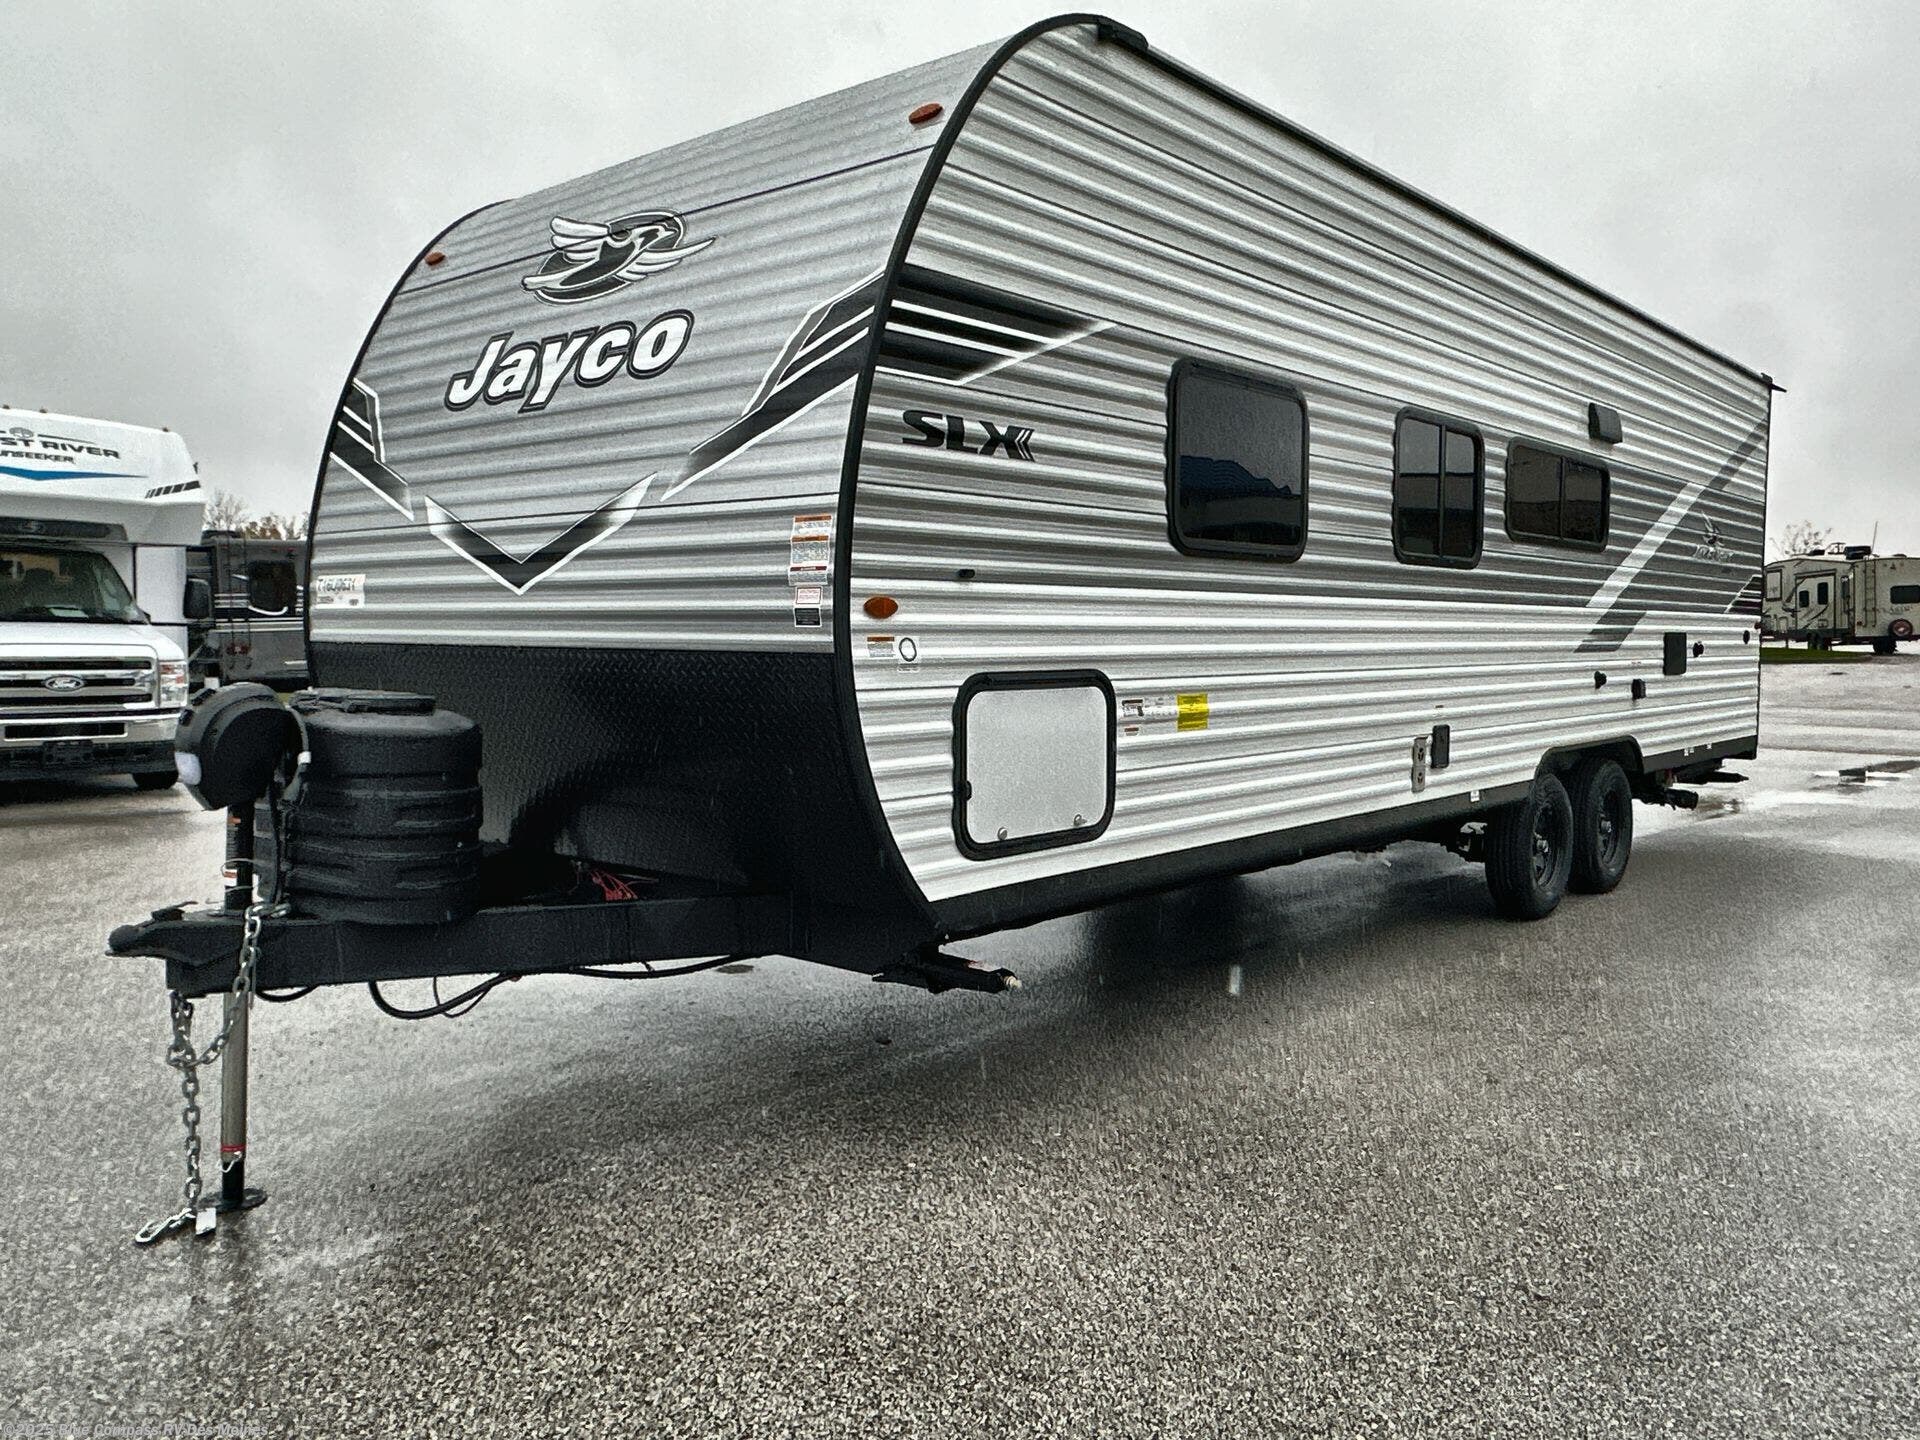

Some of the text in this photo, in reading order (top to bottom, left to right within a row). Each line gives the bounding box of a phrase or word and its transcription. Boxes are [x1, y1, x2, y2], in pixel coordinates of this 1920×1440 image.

[444, 309, 695, 414] Jayco
[40, 440, 120, 459] RIVER
[902, 409, 1035, 462] SLX
